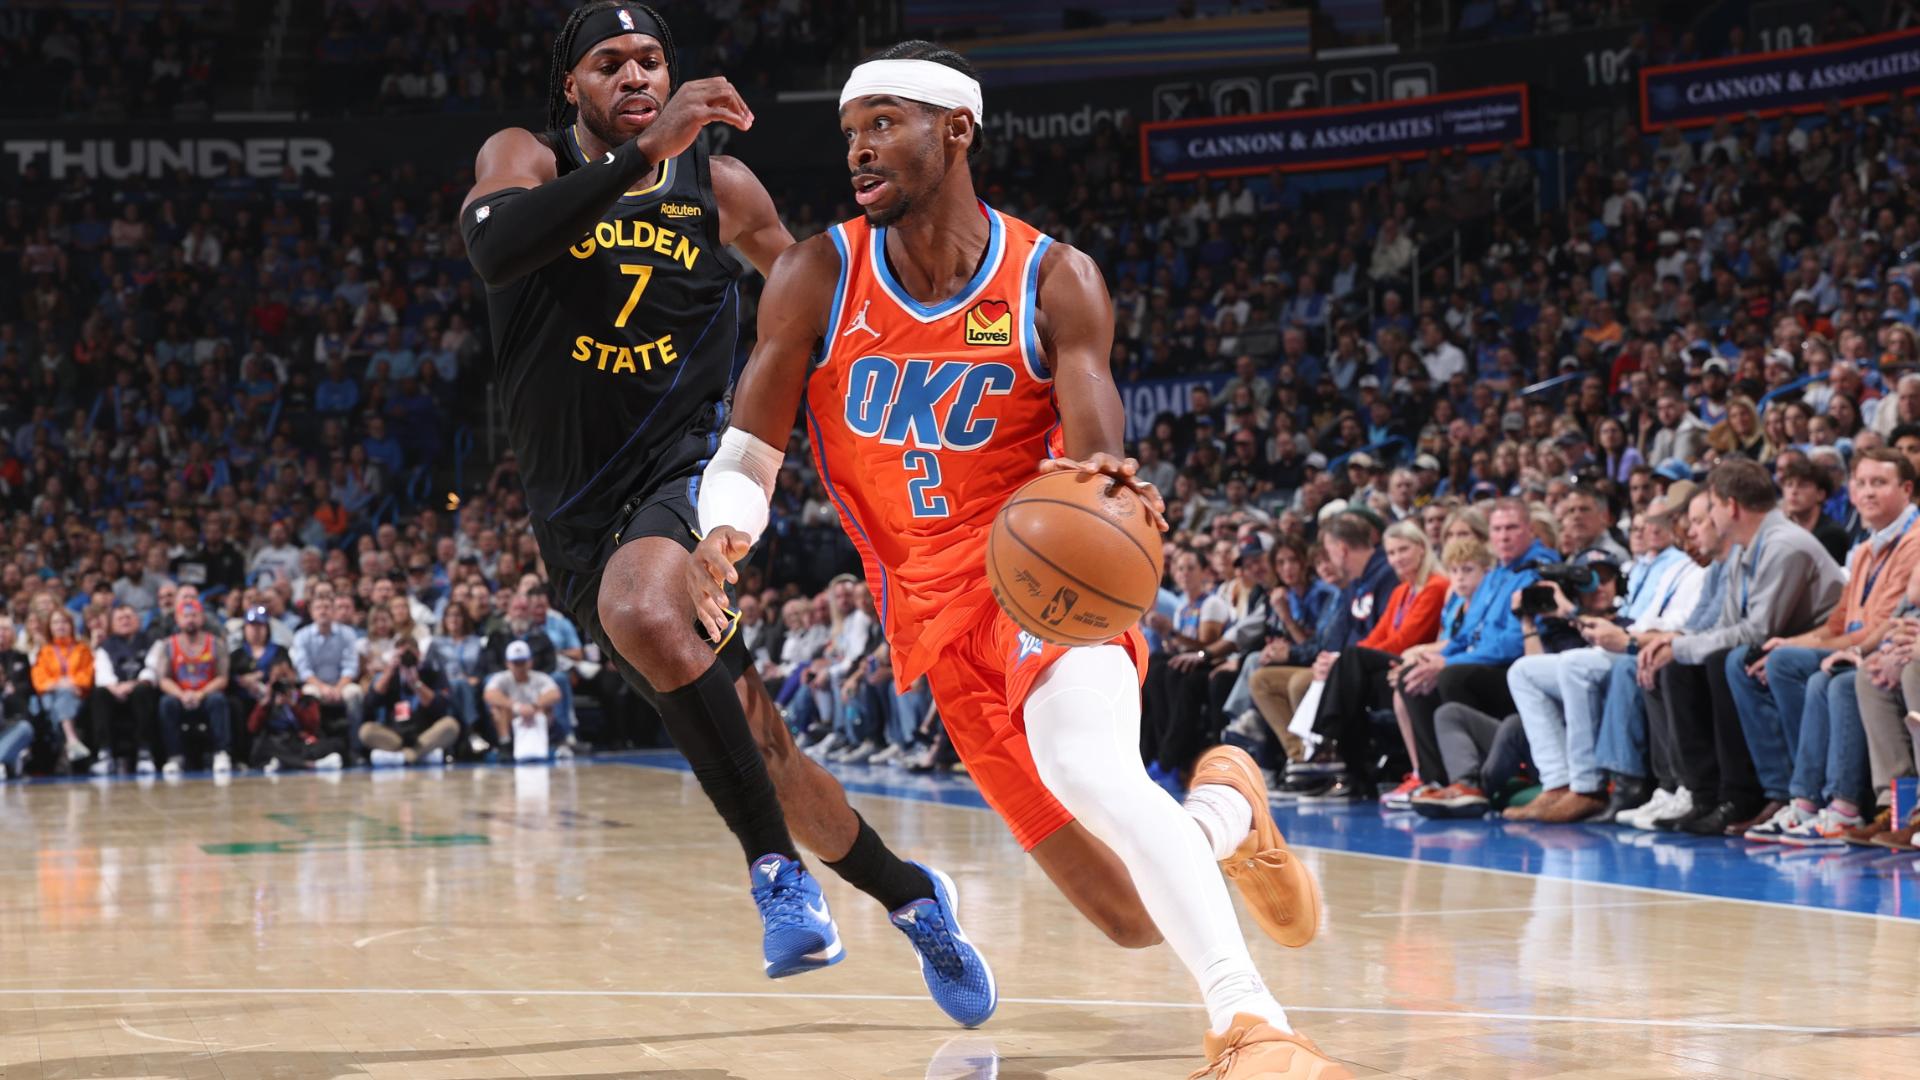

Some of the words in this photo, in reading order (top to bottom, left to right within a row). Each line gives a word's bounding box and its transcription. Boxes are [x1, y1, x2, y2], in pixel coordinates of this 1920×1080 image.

[1686, 71, 1783, 104] CANNON
[1786, 69, 1806, 92] &
[4, 139, 334, 179] THUNDER
[1187, 131, 1285, 159] CANNON
[1289, 129, 1307, 151] &
[1312, 116, 1436, 149] ASSOCIATES
[660, 202, 702, 217] Rakuten
[569, 219, 700, 271] GOLDEN
[615, 263, 654, 328] 7
[571, 334, 678, 374] STATE
[844, 355, 1016, 452] OKC
[903, 449, 950, 518] 2
